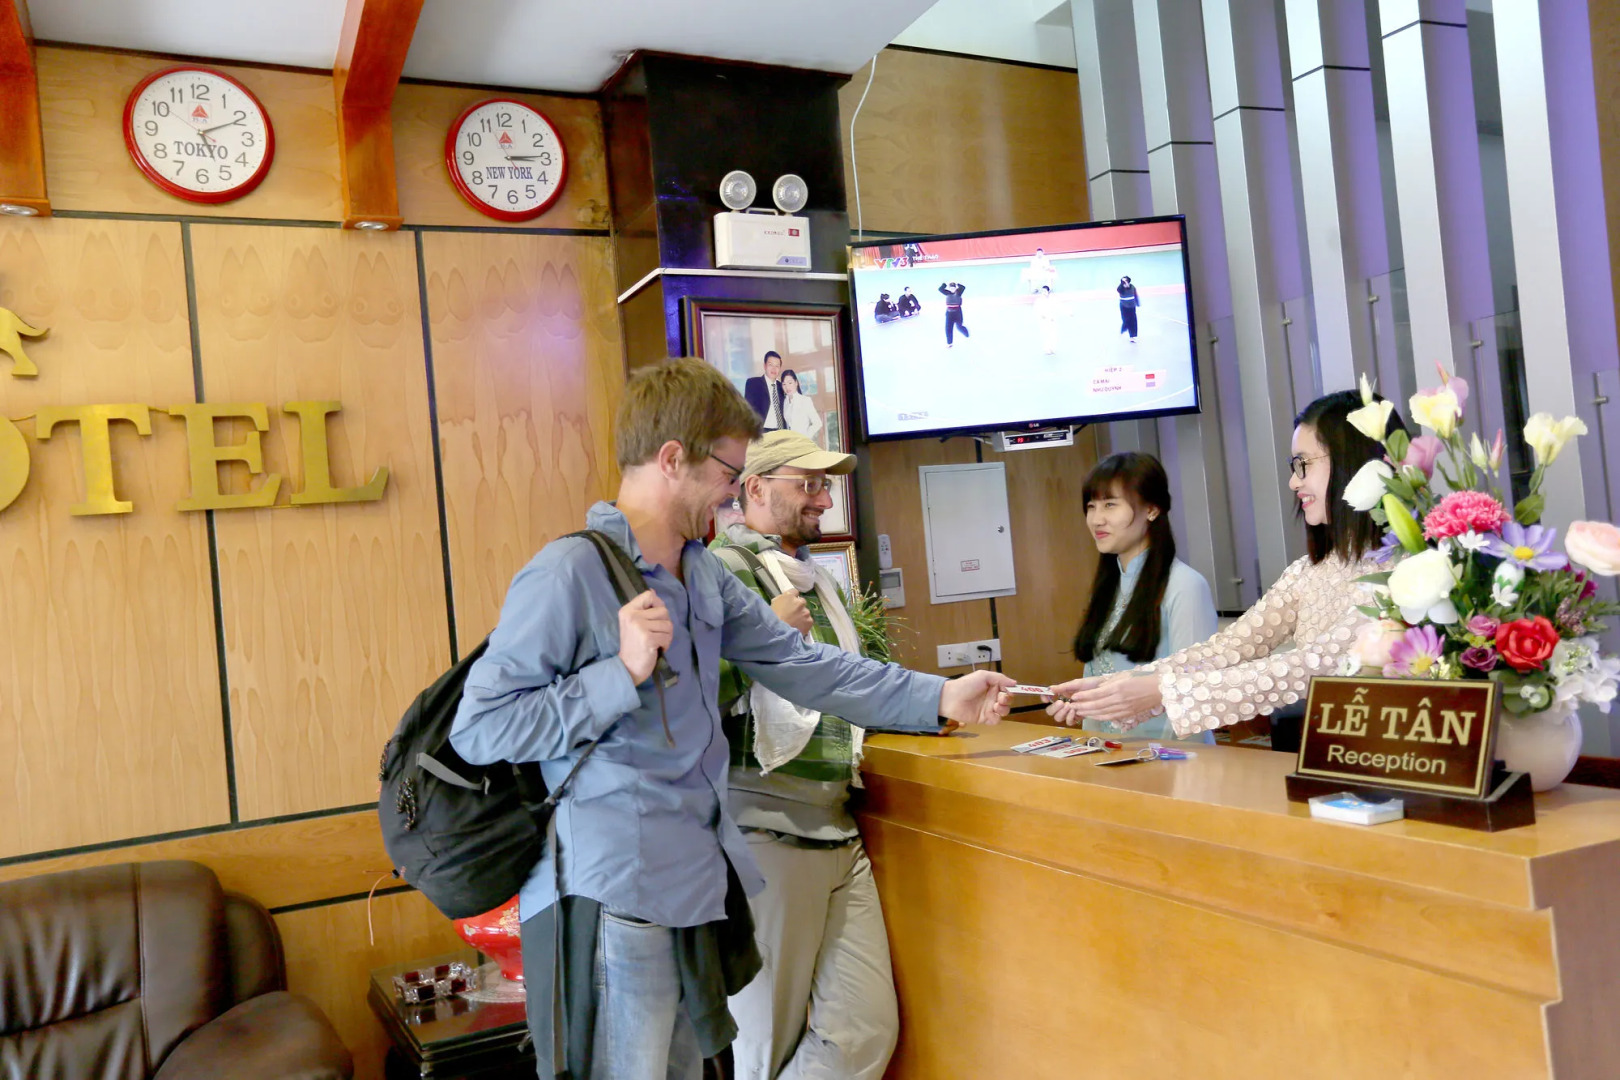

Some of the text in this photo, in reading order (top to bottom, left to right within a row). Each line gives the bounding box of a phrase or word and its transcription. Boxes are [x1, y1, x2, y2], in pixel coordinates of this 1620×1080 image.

[170, 87, 183, 104] 11
[190, 83, 210, 101] 12
[222, 93, 227, 109] 1
[152, 101, 170, 118] 10
[233, 110, 247, 127] 2
[480, 118, 492, 133] 11
[496, 112, 513, 128] 12
[522, 119, 527, 134] 1
[144, 120, 158, 136] 9
[241, 131, 255, 147] 3
[467, 132, 482, 147] 10
[532, 133, 545, 148] 2
[153, 143, 168, 159] 8
[173, 140, 228, 160] TOKYO
[235, 152, 249, 168] 4
[463, 151, 475, 166] 9
[540, 151, 552, 166] 3
[172, 159, 185, 176] 7
[218, 165, 232, 181] 5
[486, 166, 533, 180] NEW YORK
[195, 168, 210, 184] 6
[472, 170, 484, 186] 8
[537, 170, 549, 185] 4
[488, 185, 499, 199] 7
[507, 190, 519, 205] 6
[525, 184, 537, 199] 5
[874, 257, 908, 269] VTV3
[0, 400, 390, 516] TEL
[1316, 686, 1477, 746] LỄ TÂN
[1327, 744, 1447, 775] Reception
